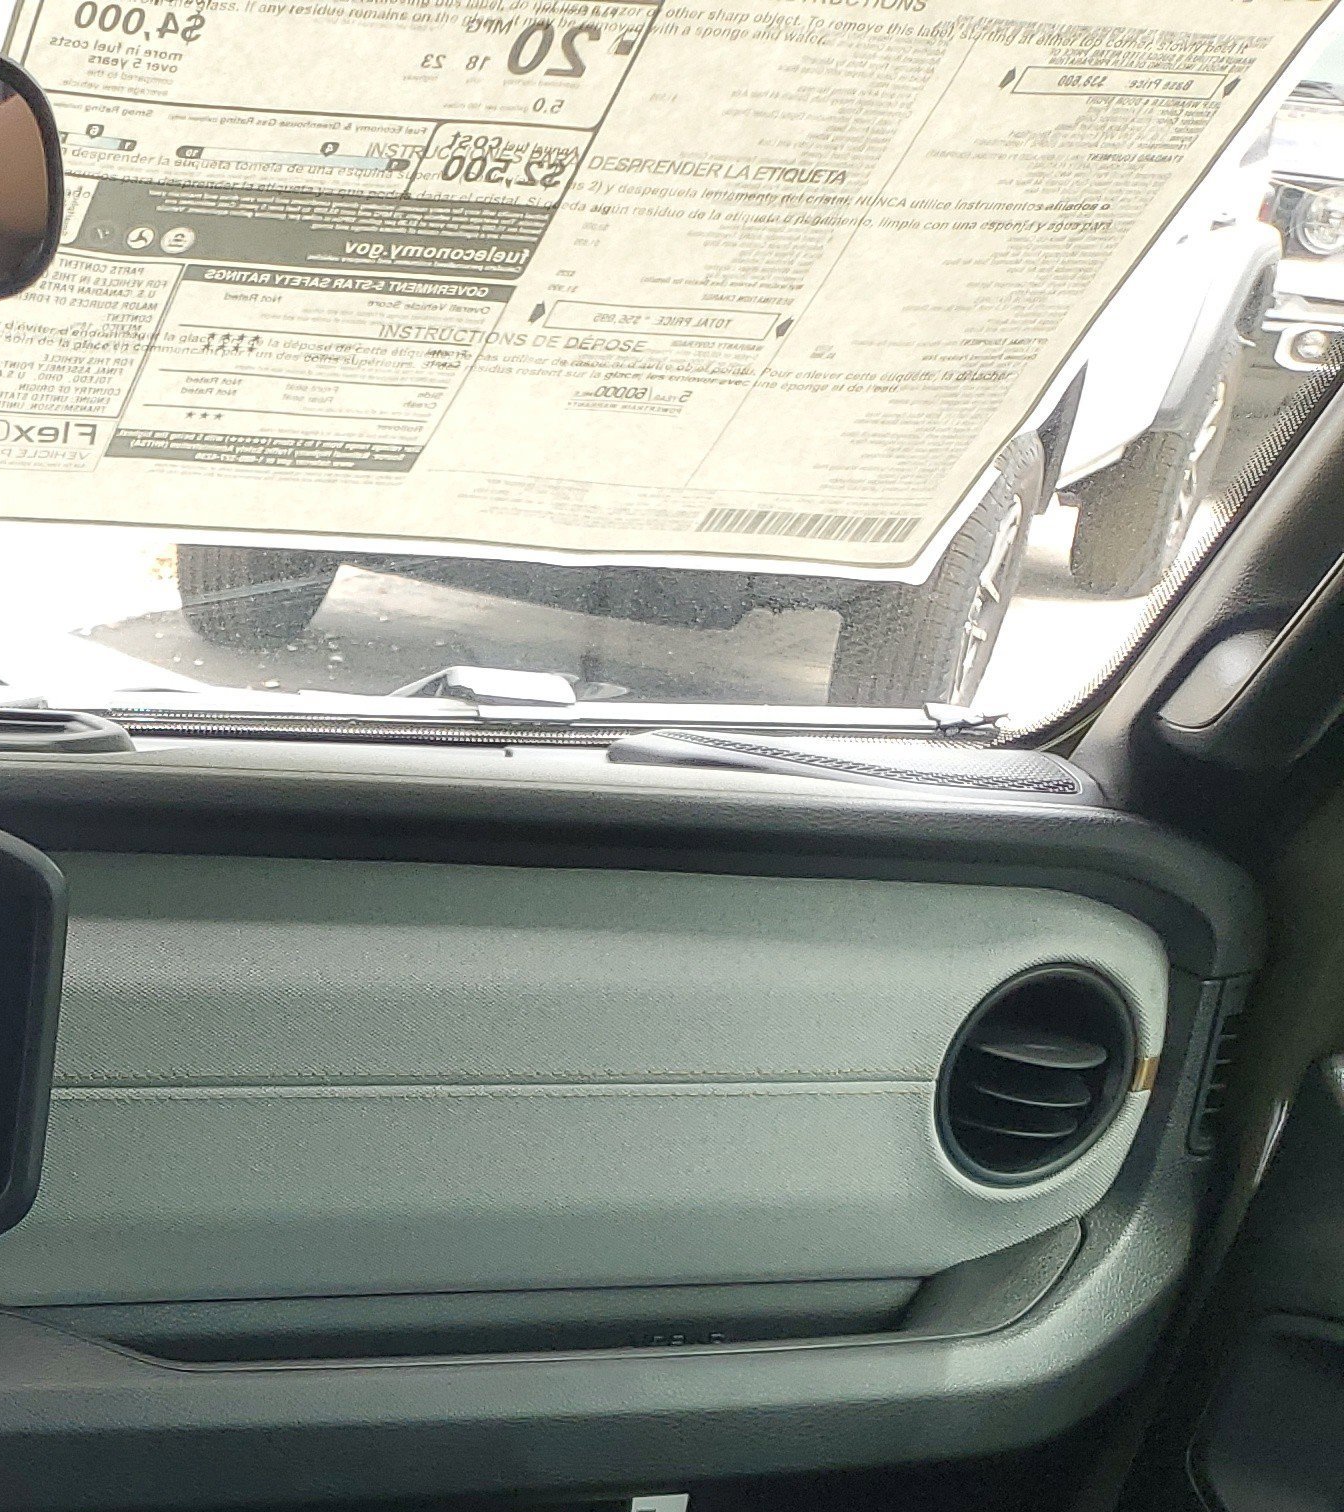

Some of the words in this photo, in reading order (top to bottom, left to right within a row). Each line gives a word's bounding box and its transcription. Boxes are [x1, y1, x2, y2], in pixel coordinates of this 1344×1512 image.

[664, 8, 706, 21] other
[707, 11, 749, 26] sharp
[808, 15, 824, 28] To
[828, 20, 883, 34] remove
[885, 21, 914, 36] this
[587, 155, 723, 180] DESPRENDER
[723, 163, 751, 180] LA
[753, 166, 848, 185] ETIQUETA
[378, 323, 528, 348] INSTRUCTIONS
[531, 334, 559, 349] DE
[562, 333, 649, 353] DÉPOSE
